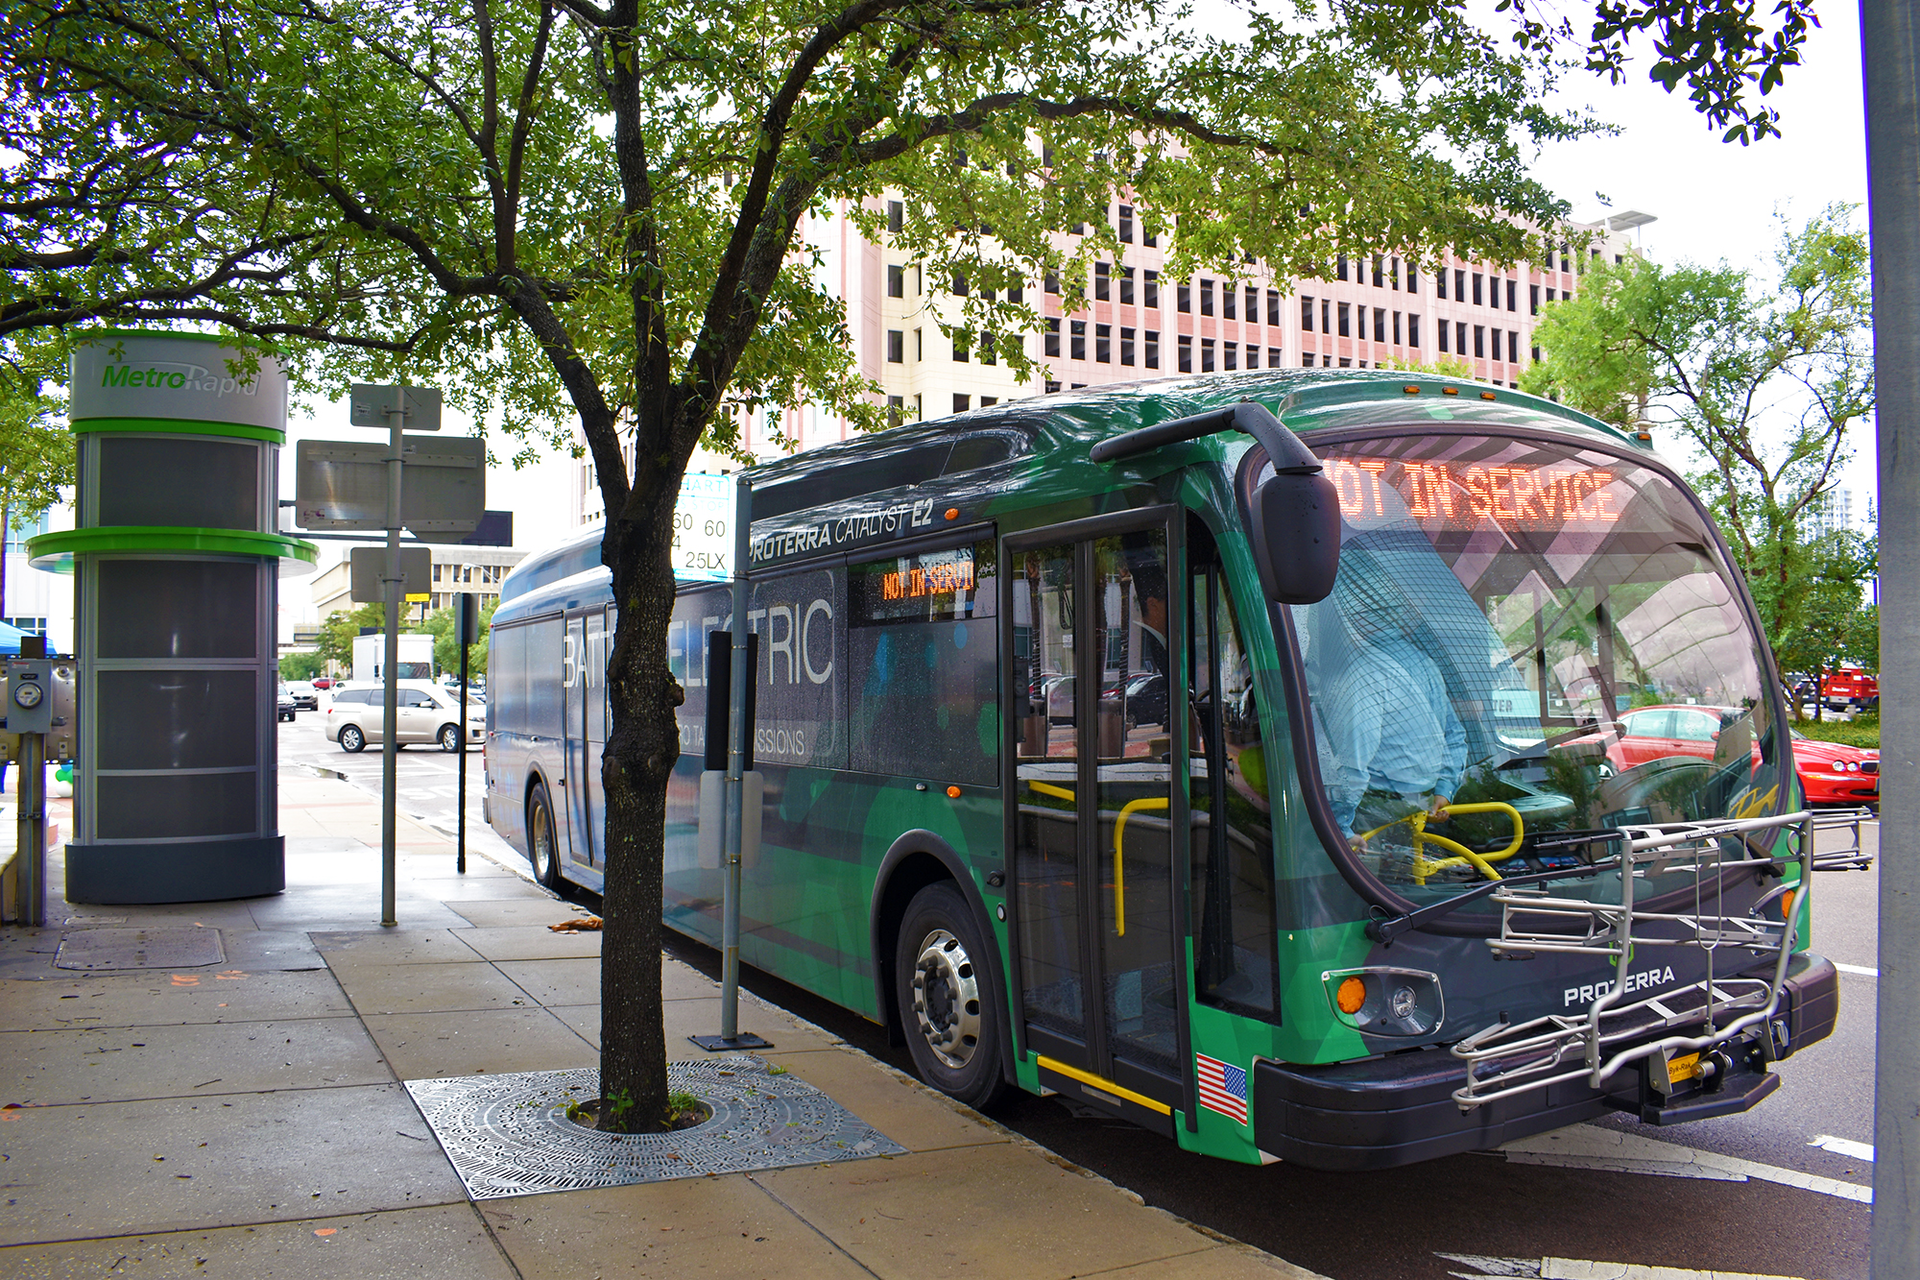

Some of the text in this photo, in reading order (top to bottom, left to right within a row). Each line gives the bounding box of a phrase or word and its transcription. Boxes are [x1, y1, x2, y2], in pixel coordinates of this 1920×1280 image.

[1404, 463, 1453, 519] IN
[1466, 466, 1619, 522] SERVICE
[704, 519, 726, 538] 60
[834, 503, 908, 544] CATALYST
[911, 498, 934, 527] E2
[685, 551, 726, 570] 25LX
[884, 572, 905, 600] NOT
[910, 568, 926, 597] IN
